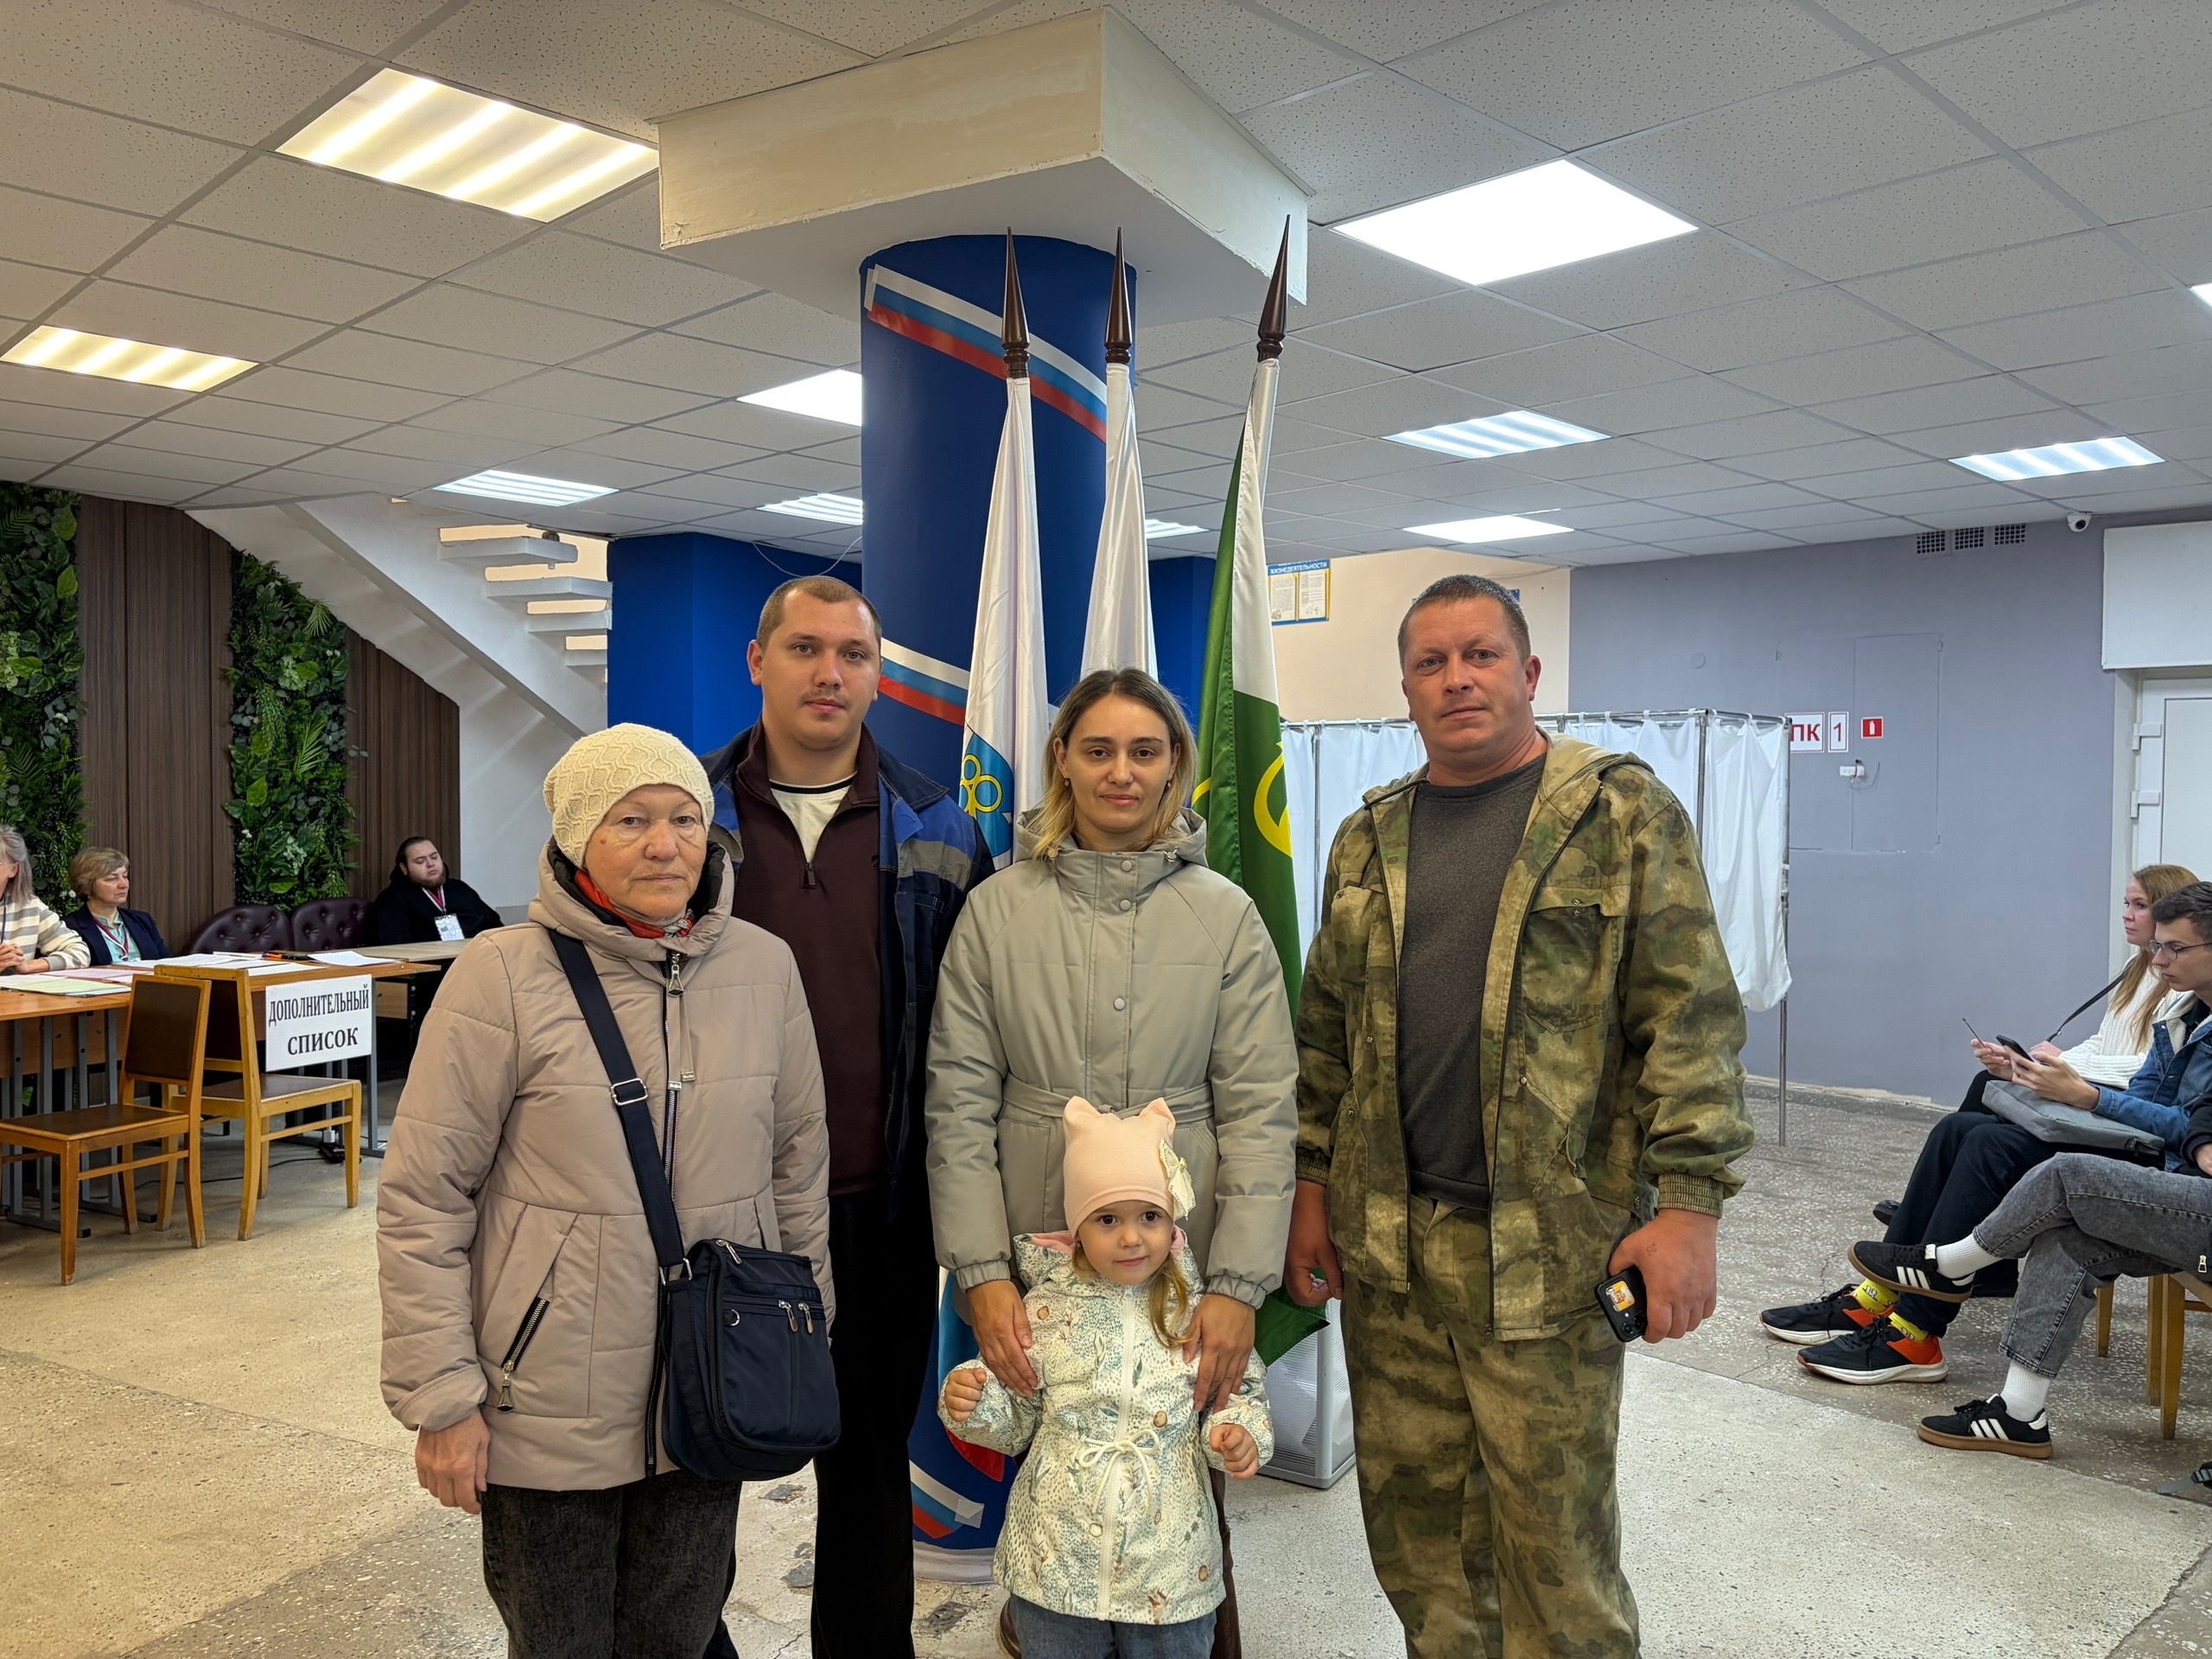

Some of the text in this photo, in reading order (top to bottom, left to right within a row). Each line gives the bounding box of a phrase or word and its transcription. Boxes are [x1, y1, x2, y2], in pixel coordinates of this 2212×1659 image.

[1269, 562, 1327, 575] ЖИЗНЕДЕЯТЕЛЬНОСТИ
[1790, 722, 1841, 741] ПК 1
[269, 983, 369, 1027] ДОПОЛНИТЕЛЬНЫЙ
[288, 1027, 358, 1055] СПИСОК
